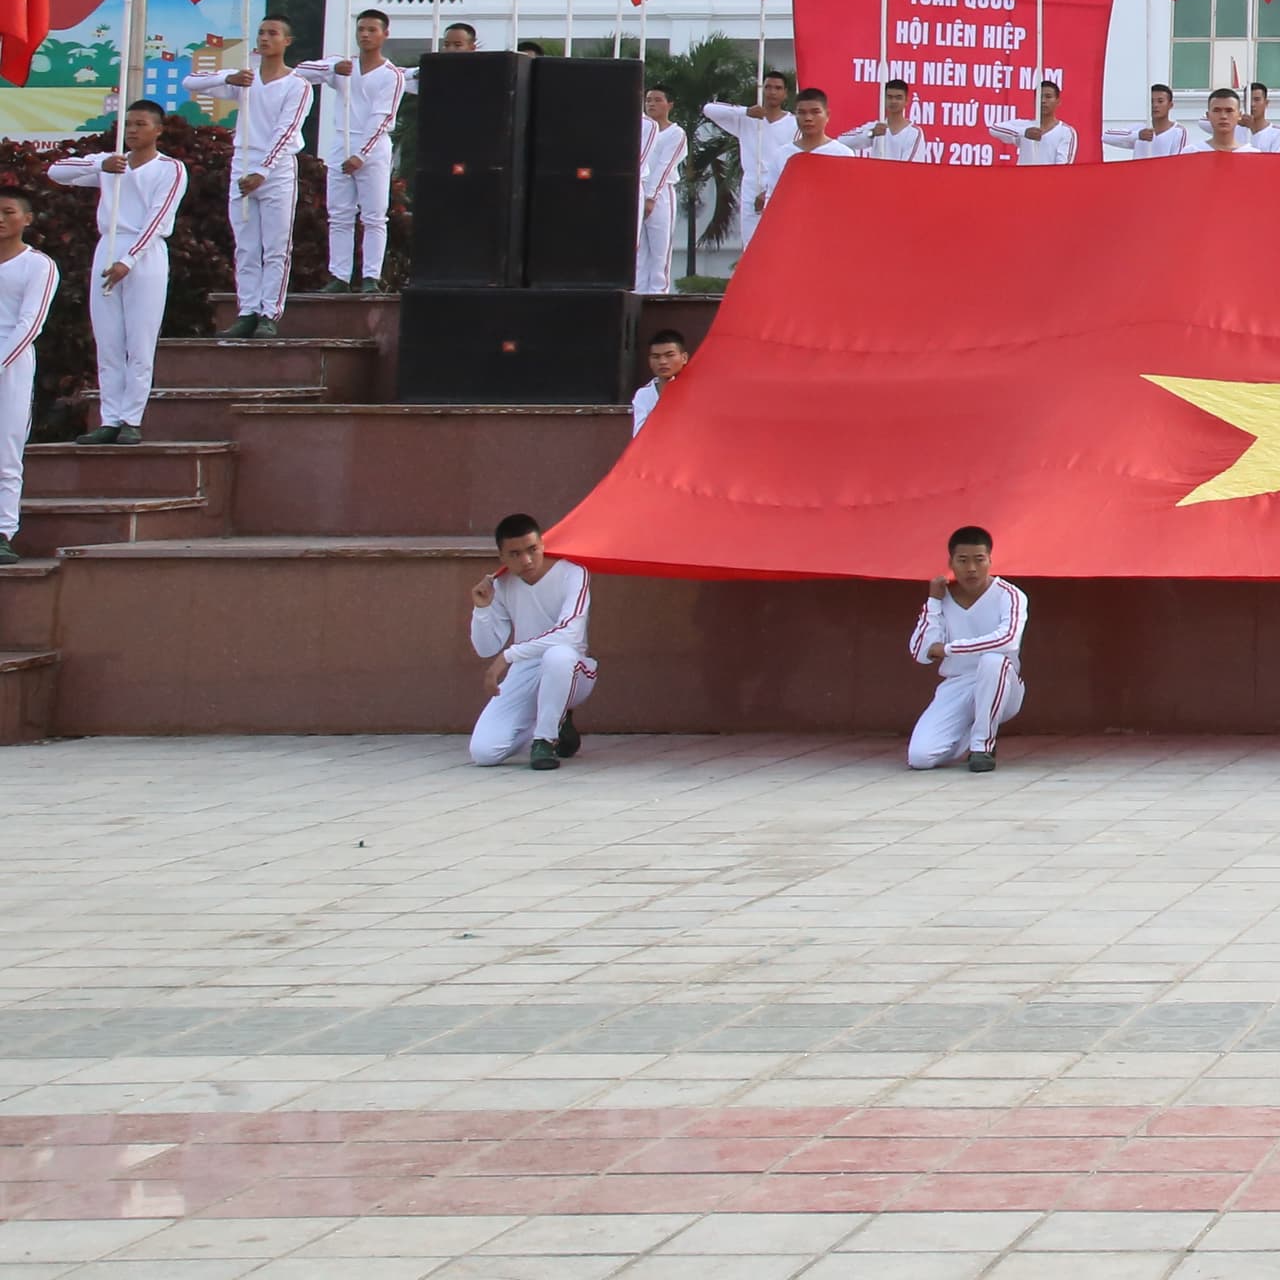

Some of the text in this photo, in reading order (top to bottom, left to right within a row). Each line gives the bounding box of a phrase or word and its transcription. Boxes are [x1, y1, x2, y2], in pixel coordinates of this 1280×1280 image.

[896, 17, 1026, 54] HỘI LIÊN HIỆP
[922, 58, 967, 86] NIÊN
[973, 61, 1013, 93] VIỆT
[903, 92, 935, 125] ẦN
[941, 99, 979, 127] THỨ
[949, 143, 993, 166] 2019
